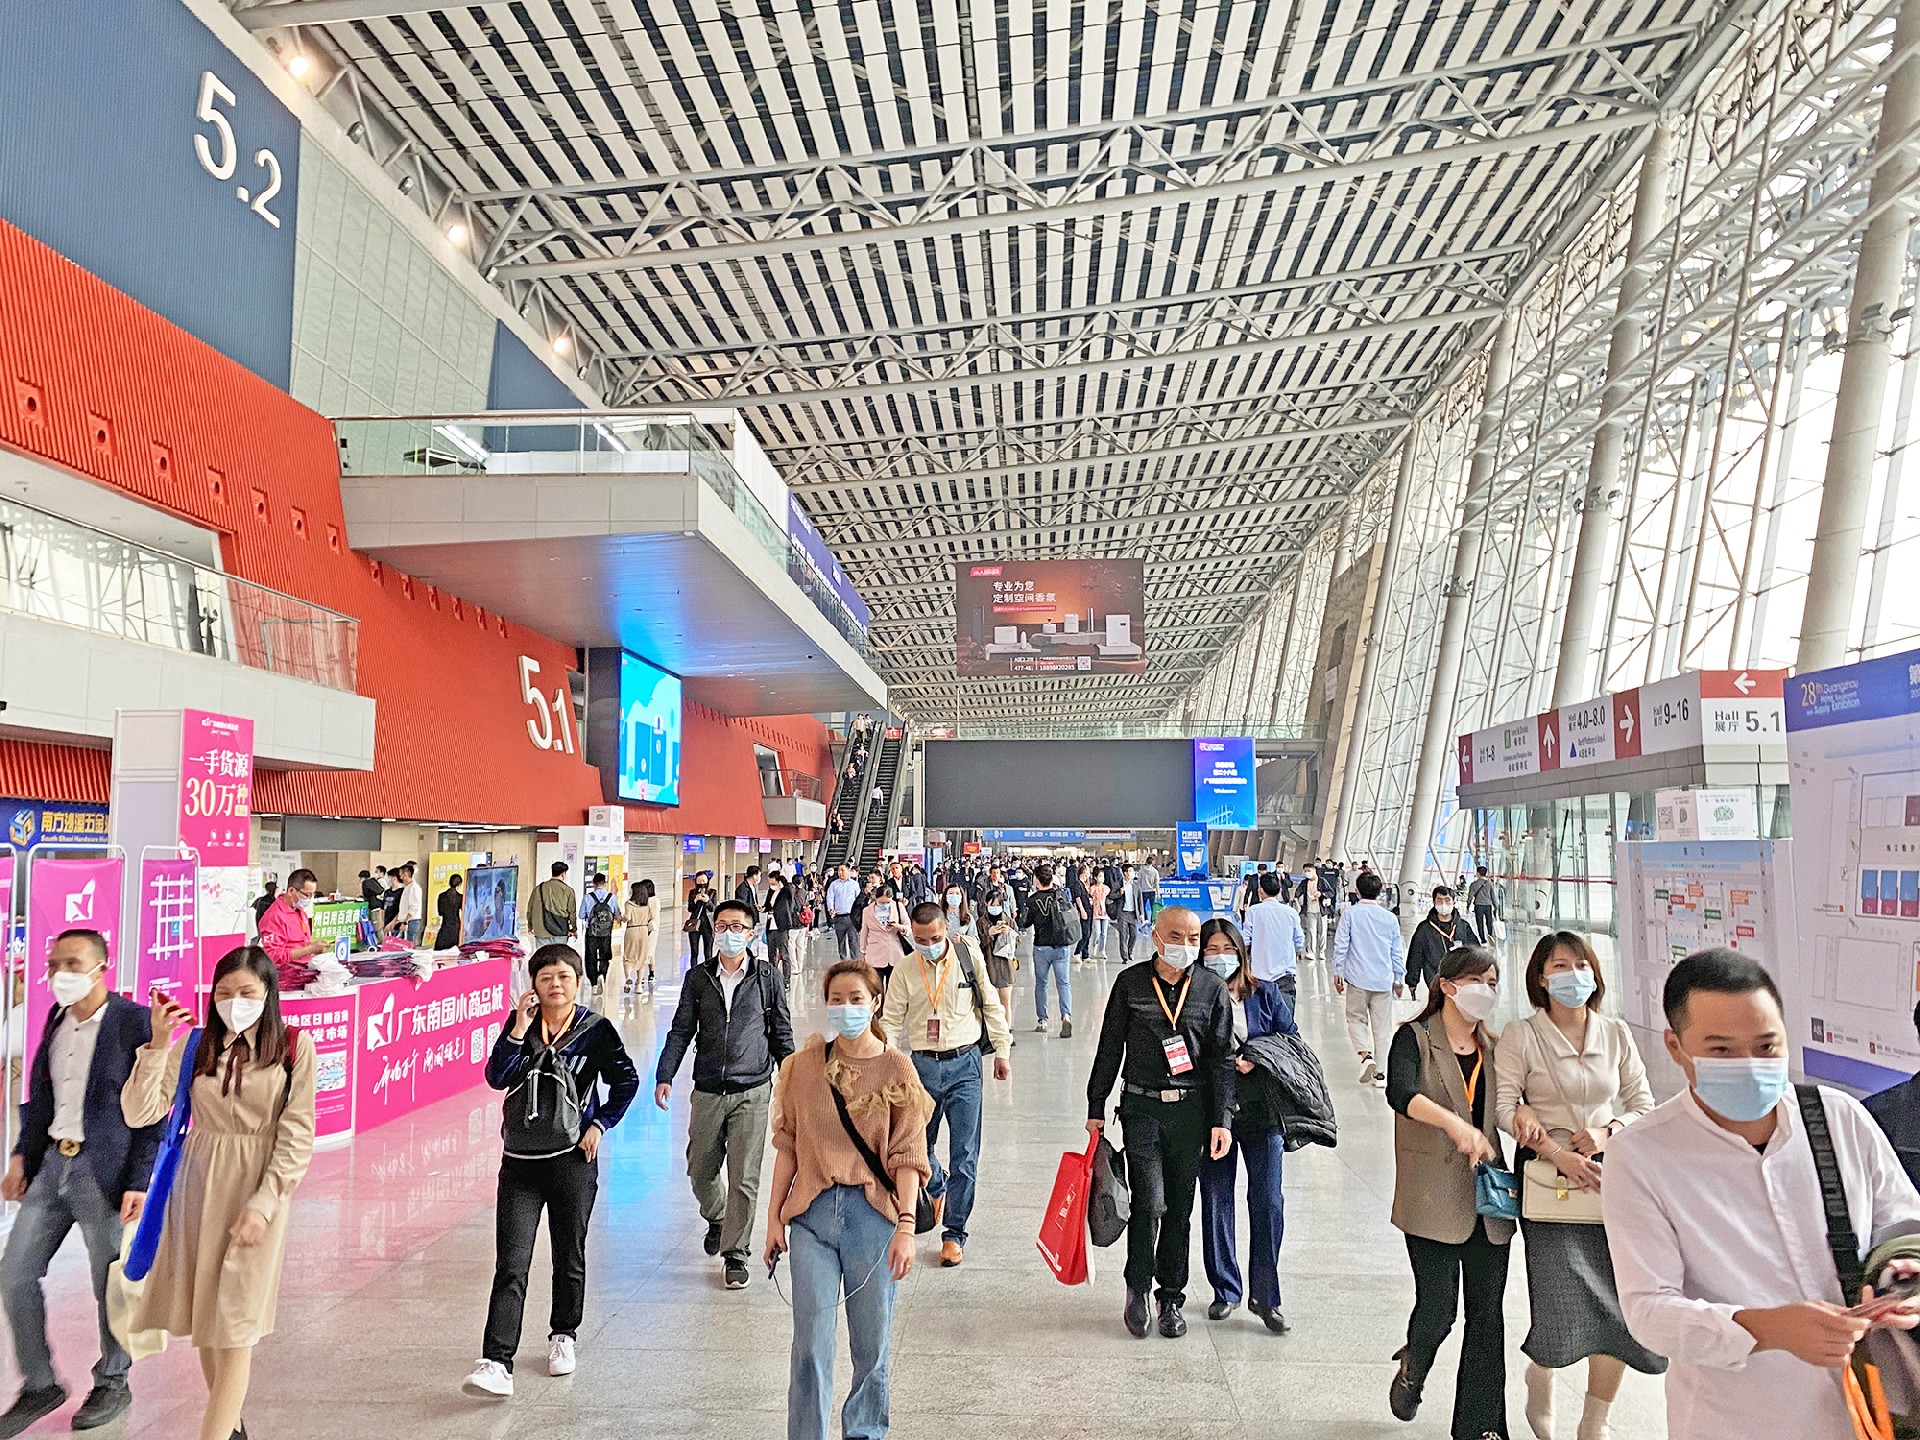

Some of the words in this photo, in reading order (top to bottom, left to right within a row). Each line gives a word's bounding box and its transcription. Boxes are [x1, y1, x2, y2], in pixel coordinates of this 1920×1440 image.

[194, 71, 282, 228] 5.2
[992, 581, 1034, 592] 专业为您
[518, 655, 574, 754] 5.1
[1663, 698, 1689, 725] 9-16
[1714, 710, 1740, 721] Hall
[1577, 705, 1606, 730] 4.0-8.0
[1714, 721, 1740, 732] 展厅
[1745, 711, 1781, 732] 5.1
[188, 748, 250, 778] 一手货源
[1486, 744, 1496, 763] 1-8
[395, 983, 504, 1042] 广东南国小商品城
